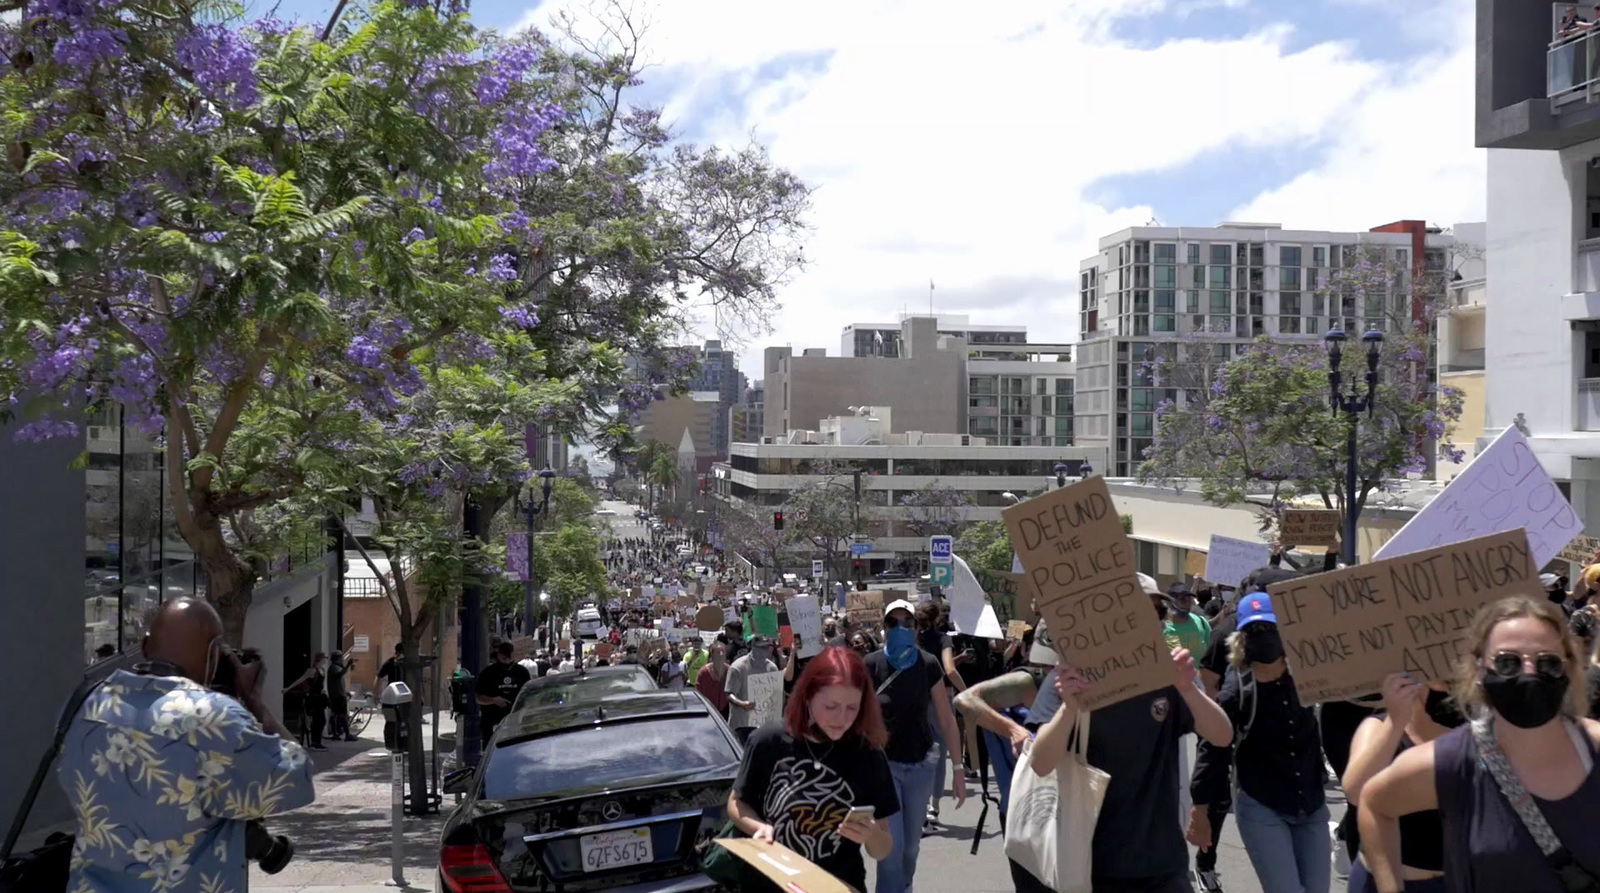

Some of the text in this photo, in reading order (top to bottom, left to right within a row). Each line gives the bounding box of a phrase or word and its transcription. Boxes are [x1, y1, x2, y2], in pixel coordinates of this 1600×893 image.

[1501, 441, 1576, 530] STOP
[1018, 492, 1108, 550] DEFUND
[1053, 535, 1083, 556] THE
[933, 542, 950, 553] ACE
[935, 566, 948, 581] P
[1031, 541, 1126, 597] POLICE
[1055, 580, 1135, 632] STOP
[1274, 585, 1307, 626] IF
[1389, 553, 1444, 610] NOT
[1451, 540, 1529, 596] ANGRY
[1057, 611, 1137, 662] POLICE
[1358, 622, 1394, 654] NOT
[1405, 602, 1486, 644] PAYIN
[587, 841, 648, 866] 6ZFS675
